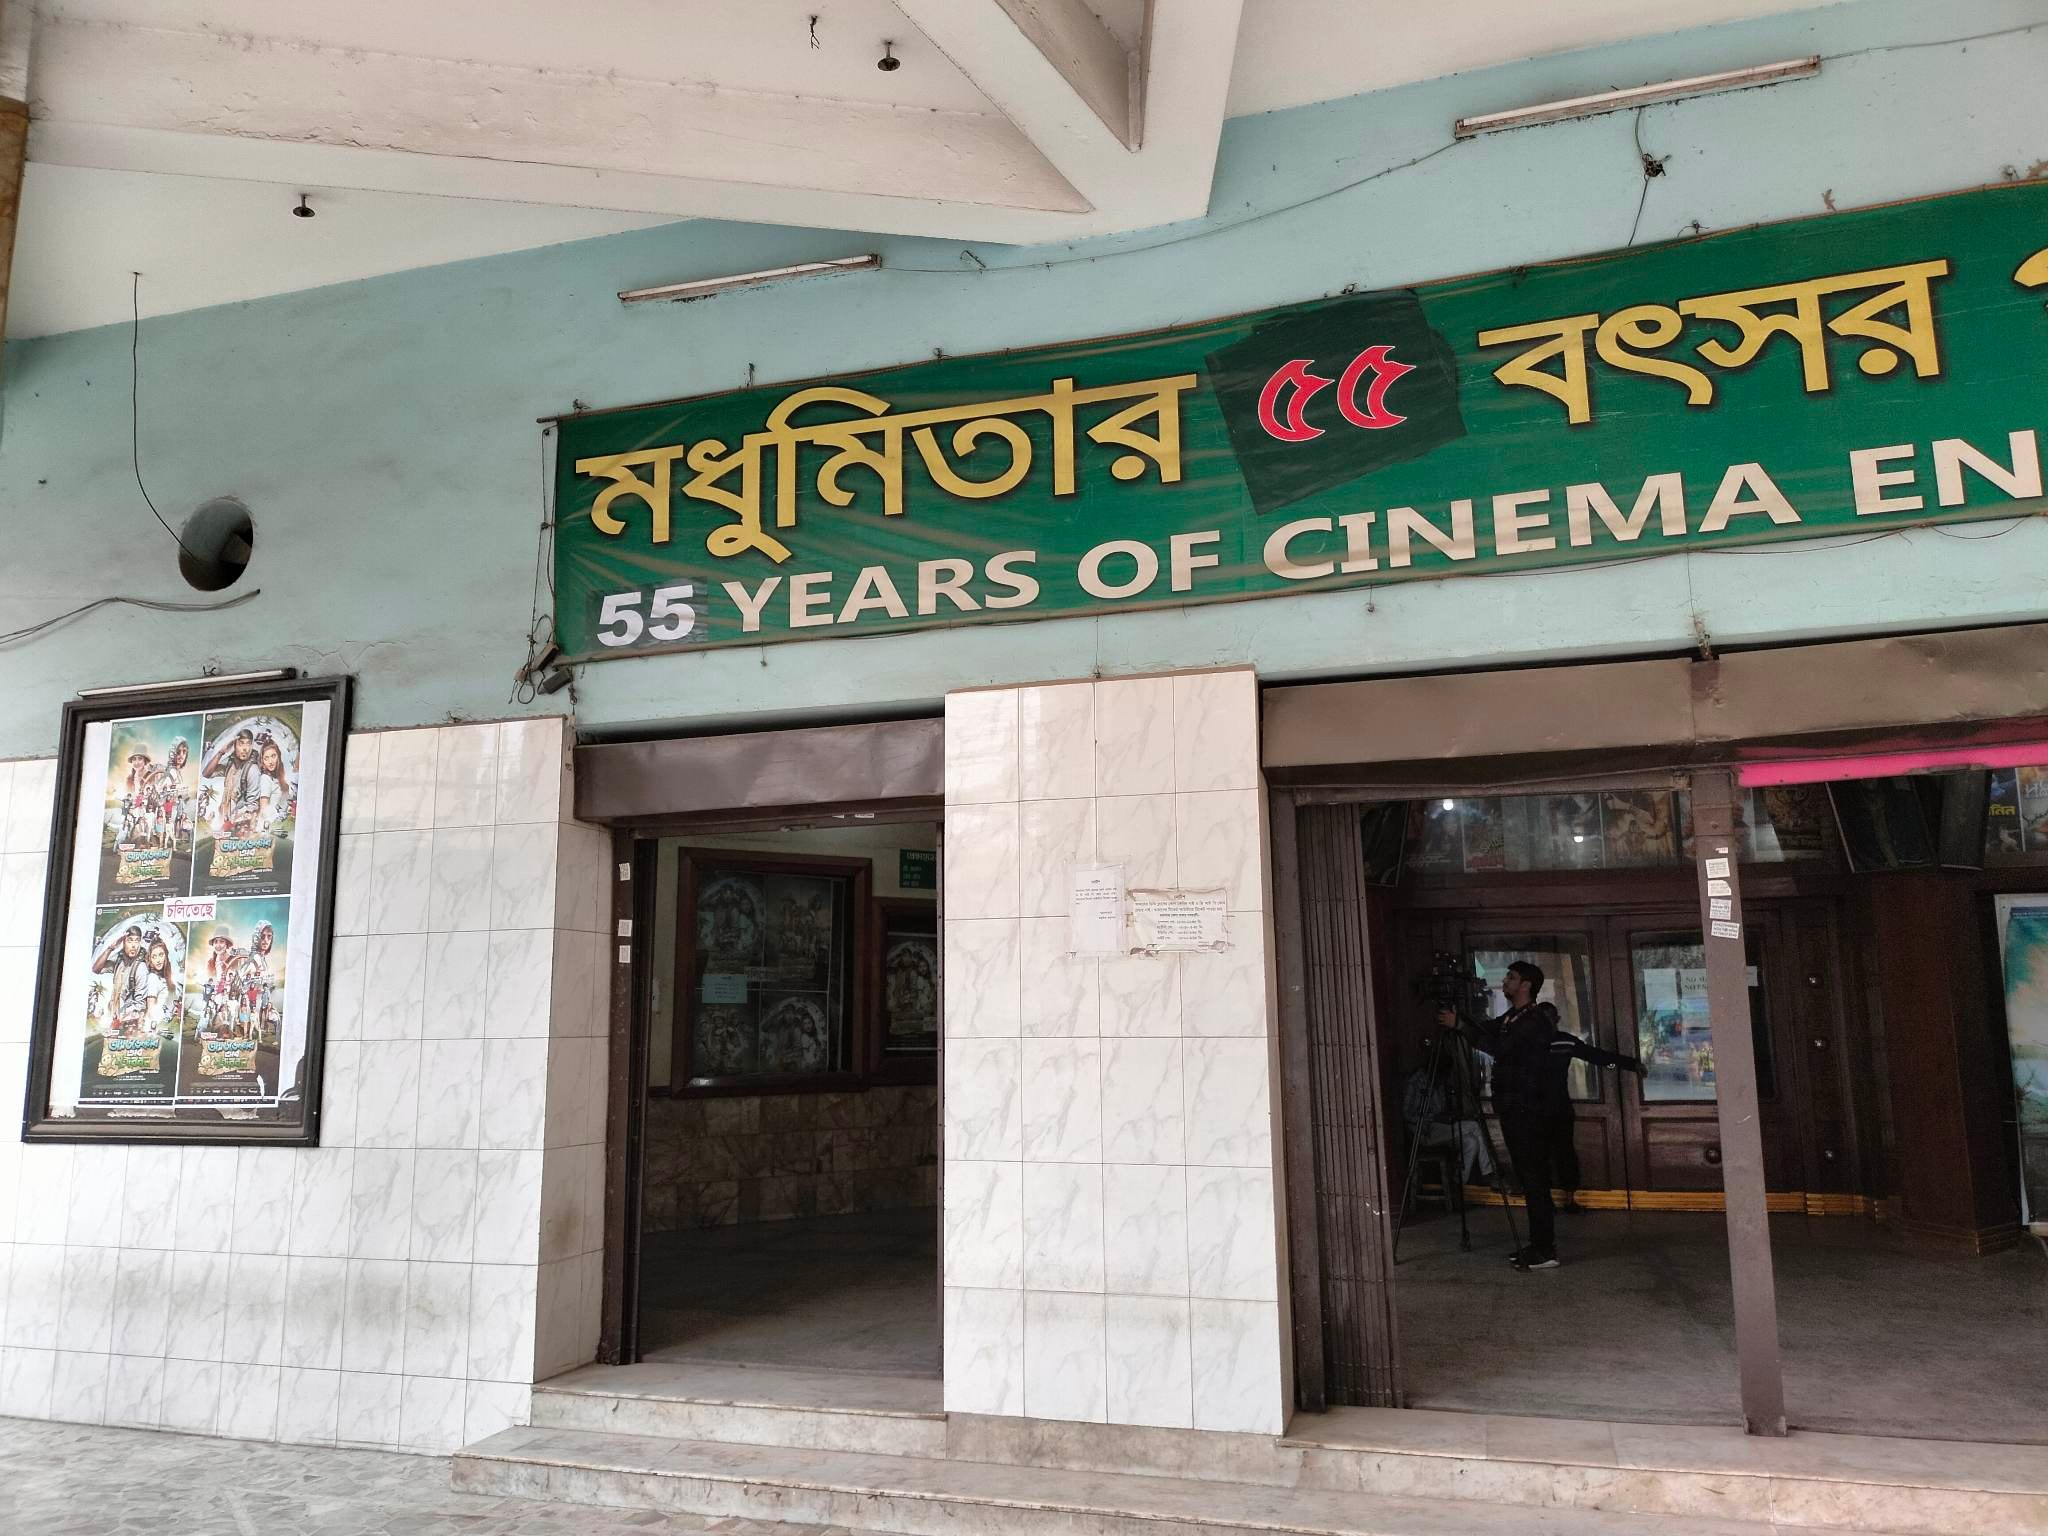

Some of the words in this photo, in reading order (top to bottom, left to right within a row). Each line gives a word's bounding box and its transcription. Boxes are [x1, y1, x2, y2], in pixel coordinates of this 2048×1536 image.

[574, 374, 1198, 564] মধুমিতার
[1256, 344, 1418, 443] ৫৫
[1477, 258, 1949, 426] বৎসর
[595, 584, 698, 647] 55
[721, 550, 1041, 633] YEARS
[1077, 529, 1221, 600] OF
[1262, 462, 1803, 580] CINEMA
[166, 899, 215, 919] চলিতেছে
